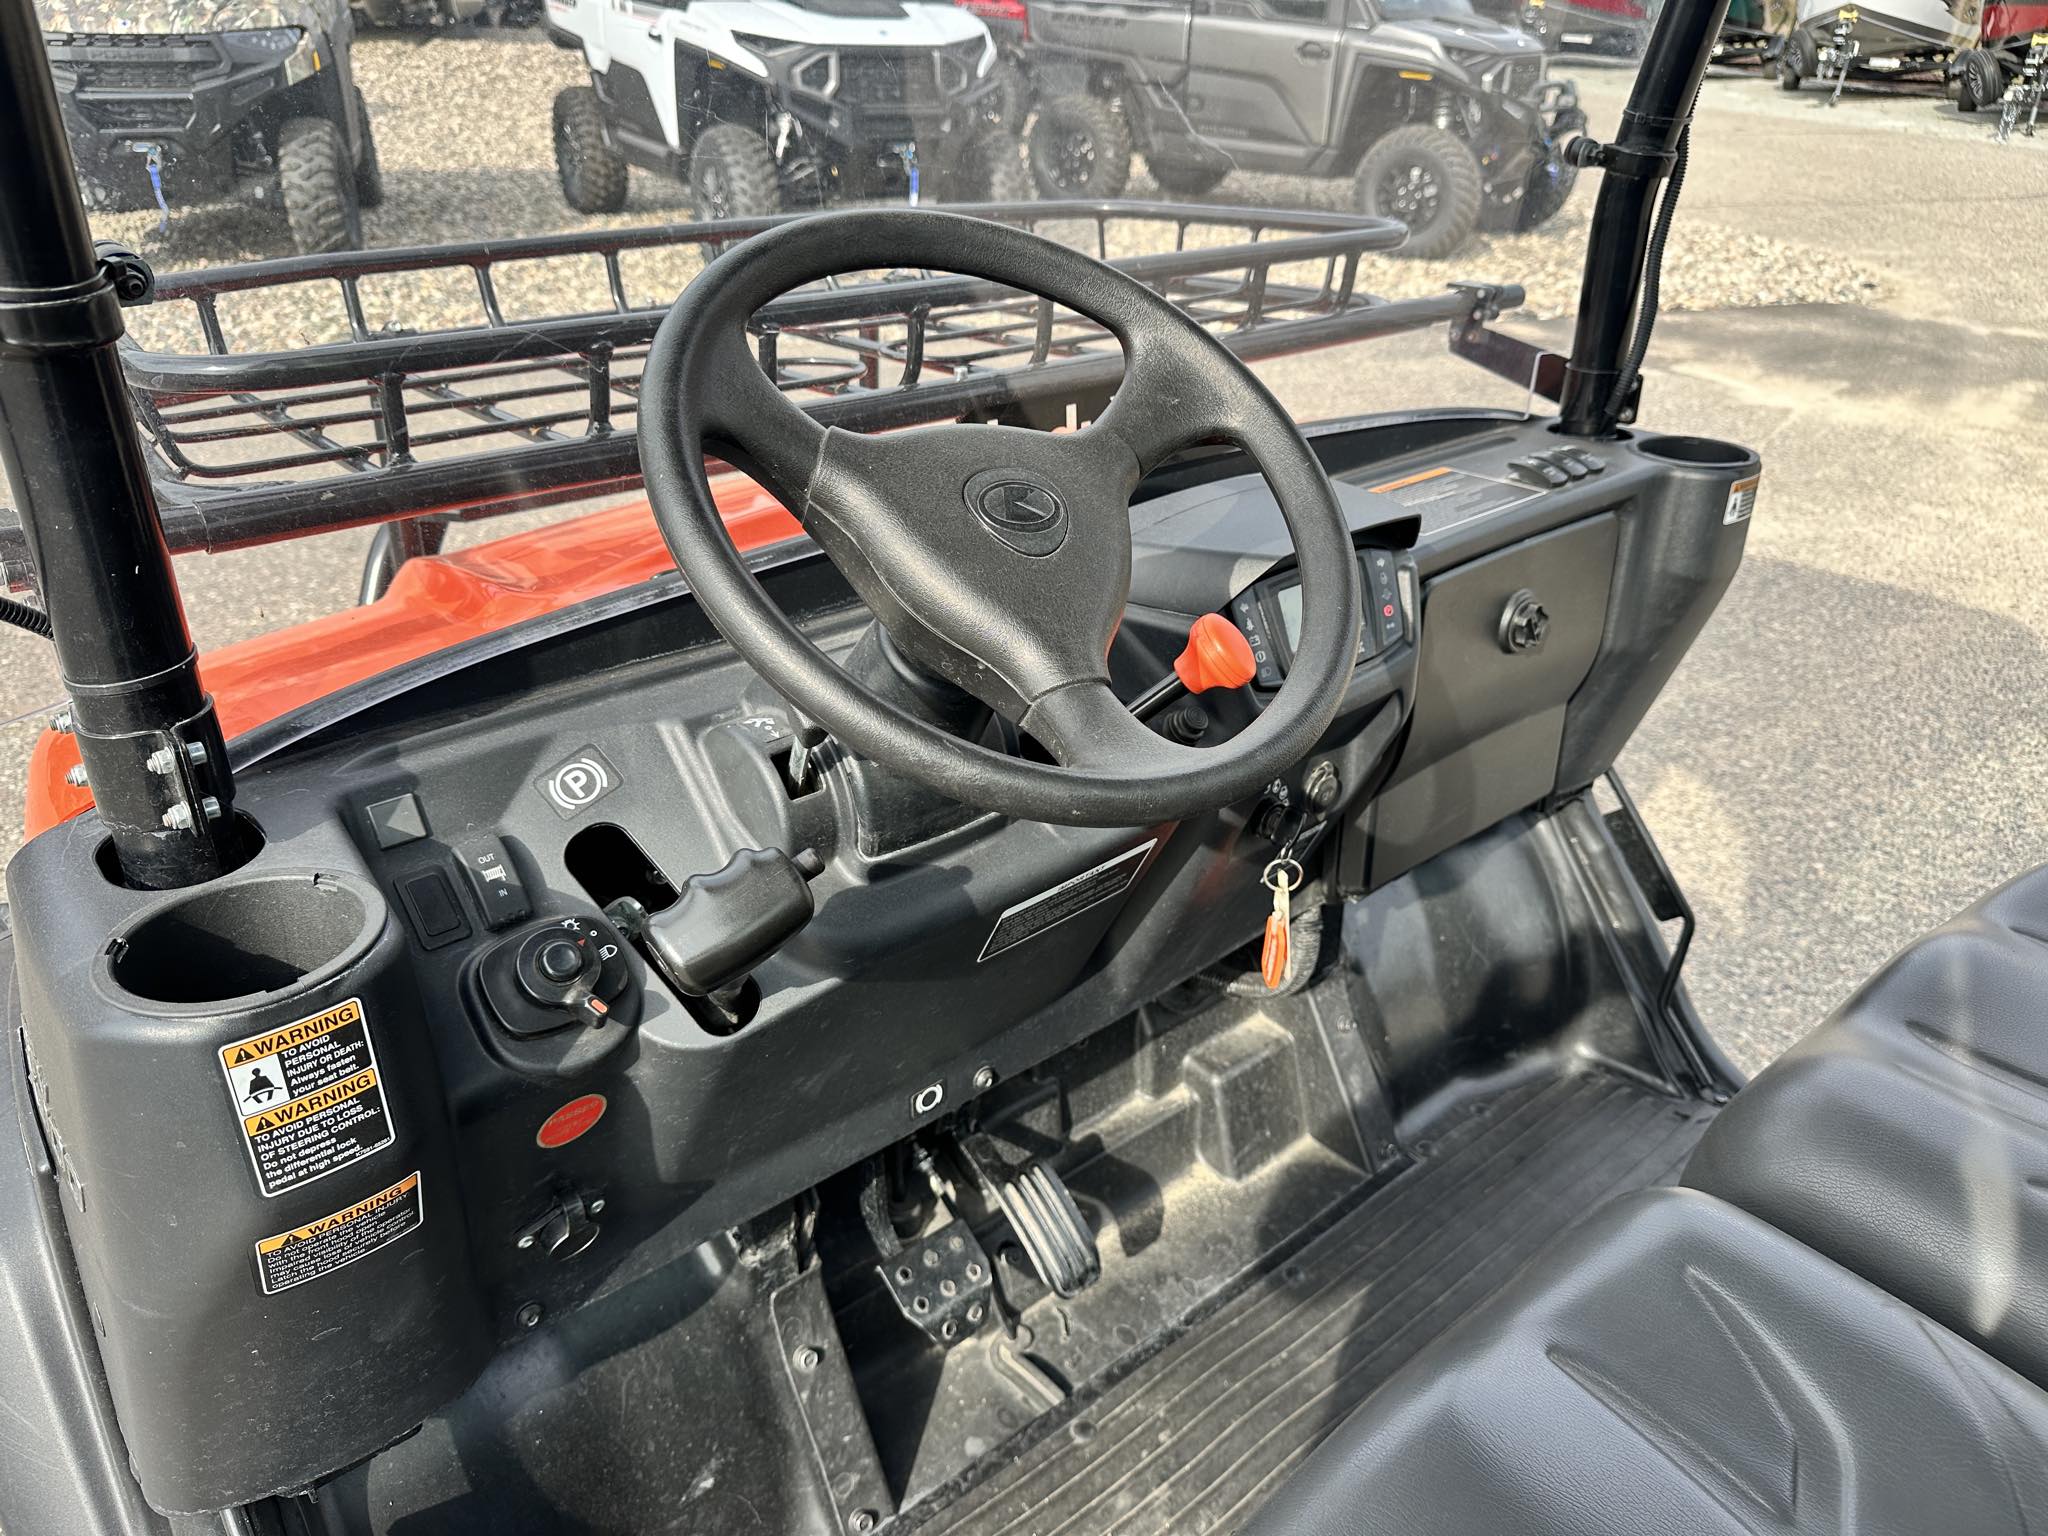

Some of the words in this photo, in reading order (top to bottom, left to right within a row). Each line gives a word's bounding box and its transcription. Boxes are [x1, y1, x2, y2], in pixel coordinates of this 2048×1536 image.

[478, 854, 494, 864] OUT
[498, 888, 508, 896] IN
[254, 1008, 354, 1055] WARNING
[282, 1048, 296, 1059] TO
[300, 1035, 330, 1053] AVOID
[285, 1041, 341, 1068] PERSONAL
[287, 1060, 317, 1078] INJURY
[320, 1055, 332, 1064] OR
[334, 1040, 364, 1059] DEATH:
[291, 1068, 325, 1086] Always
[327, 1055, 356, 1071] fasten
[293, 1082, 316, 1097] your
[317, 1073, 337, 1086] seat
[339, 1065, 359, 1078] belt.
[255, 1132, 270, 1143] TO
[273, 1120, 303, 1139] AVOID
[306, 1097, 360, 1124] PERSONAL
[274, 1074, 371, 1122] WARNING
[257, 1135, 294, 1153] INJURY
[298, 1124, 319, 1137] DUE
[321, 1117, 334, 1128] TO
[337, 1105, 363, 1120] LOSS
[261, 1150, 276, 1161] OF
[279, 1130, 329, 1156] STEERING
[331, 1107, 381, 1135] CONTROL:
[263, 1161, 277, 1170] Do
[280, 1154, 297, 1164] not
[298, 1137, 336, 1159] depress
[266, 1168, 282, 1179] the
[284, 1147, 335, 1172] differential
[337, 1137, 357, 1150] lock
[268, 1173, 296, 1189] pedal
[298, 1166, 308, 1177] at
[309, 1156, 331, 1173] high
[333, 1143, 363, 1163] speed.
[268, 1249, 281, 1258] TO
[284, 1237, 316, 1252] AVOID
[319, 1213, 372, 1240] PERSONAL
[375, 1193, 408, 1214] INJURY
[308, 1187, 402, 1235] WARNING
[268, 1256, 282, 1264] Do
[284, 1249, 300, 1259] not
[302, 1235, 337, 1252] operate
[340, 1227, 353, 1236] the
[355, 1210, 386, 1229] vehicle
[268, 1258, 288, 1268] with
[290, 1253, 305, 1261] the
[308, 1243, 328, 1254] front
[331, 1232, 353, 1245] hood
[269, 1256, 310, 1273] Impaired
[313, 1240, 348, 1257] visibility
[350, 1234, 359, 1243] of
[361, 1227, 375, 1239] the
[377, 1208, 411, 1228] operator
[270, 1269, 290, 1279] may
[293, 1258, 321, 1270] cause
[323, 1249, 342, 1259] loss
[344, 1242, 353, 1250] of
[355, 1228, 384, 1245] vehicle
[386, 1211, 414, 1230] control
[272, 1272, 297, 1283] Latch
[300, 1265, 314, 1274] the
[317, 1254, 340, 1267] hood
[342, 1237, 378, 1256] securely
[379, 1221, 406, 1239] before
[272, 1270, 316, 1289] operating
[318, 1263, 333, 1272] the
